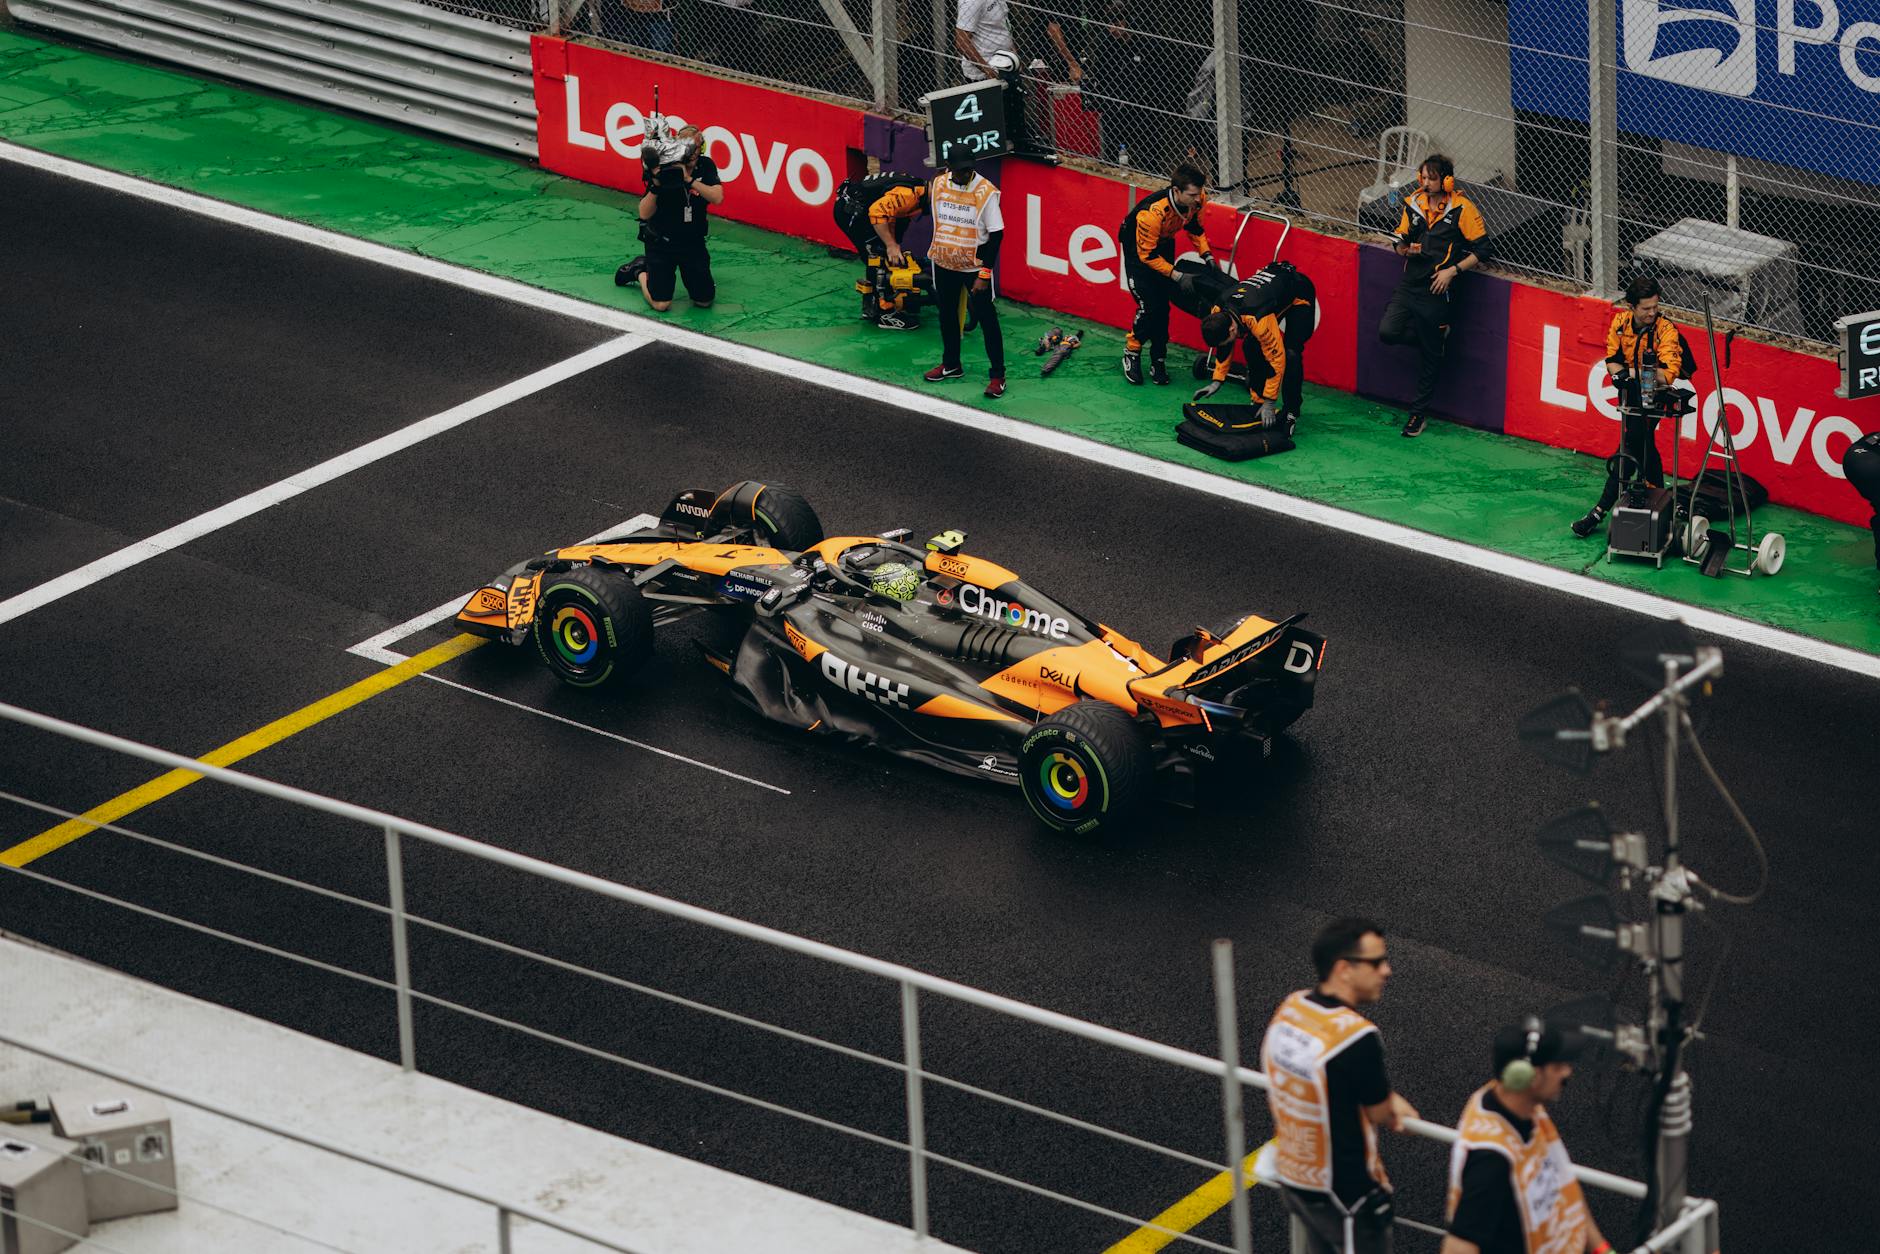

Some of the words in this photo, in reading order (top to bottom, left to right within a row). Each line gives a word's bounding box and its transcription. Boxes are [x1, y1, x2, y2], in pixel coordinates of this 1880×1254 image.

[955, 94, 983, 123] 4
[1860, 322, 1880, 355] 6
[1859, 367, 1880, 390] R
[940, 558, 968, 575] OXXO
[730, 570, 755, 582] RICHARD
[755, 577, 773, 587] MILLE
[481, 594, 505, 609] OXXO
[734, 584, 746, 593] DP
[746, 586, 763, 597] WOR
[959, 584, 1070, 639] Chrome
[1284, 640, 1314, 674] D
[1040, 666, 1072, 688] DELL
